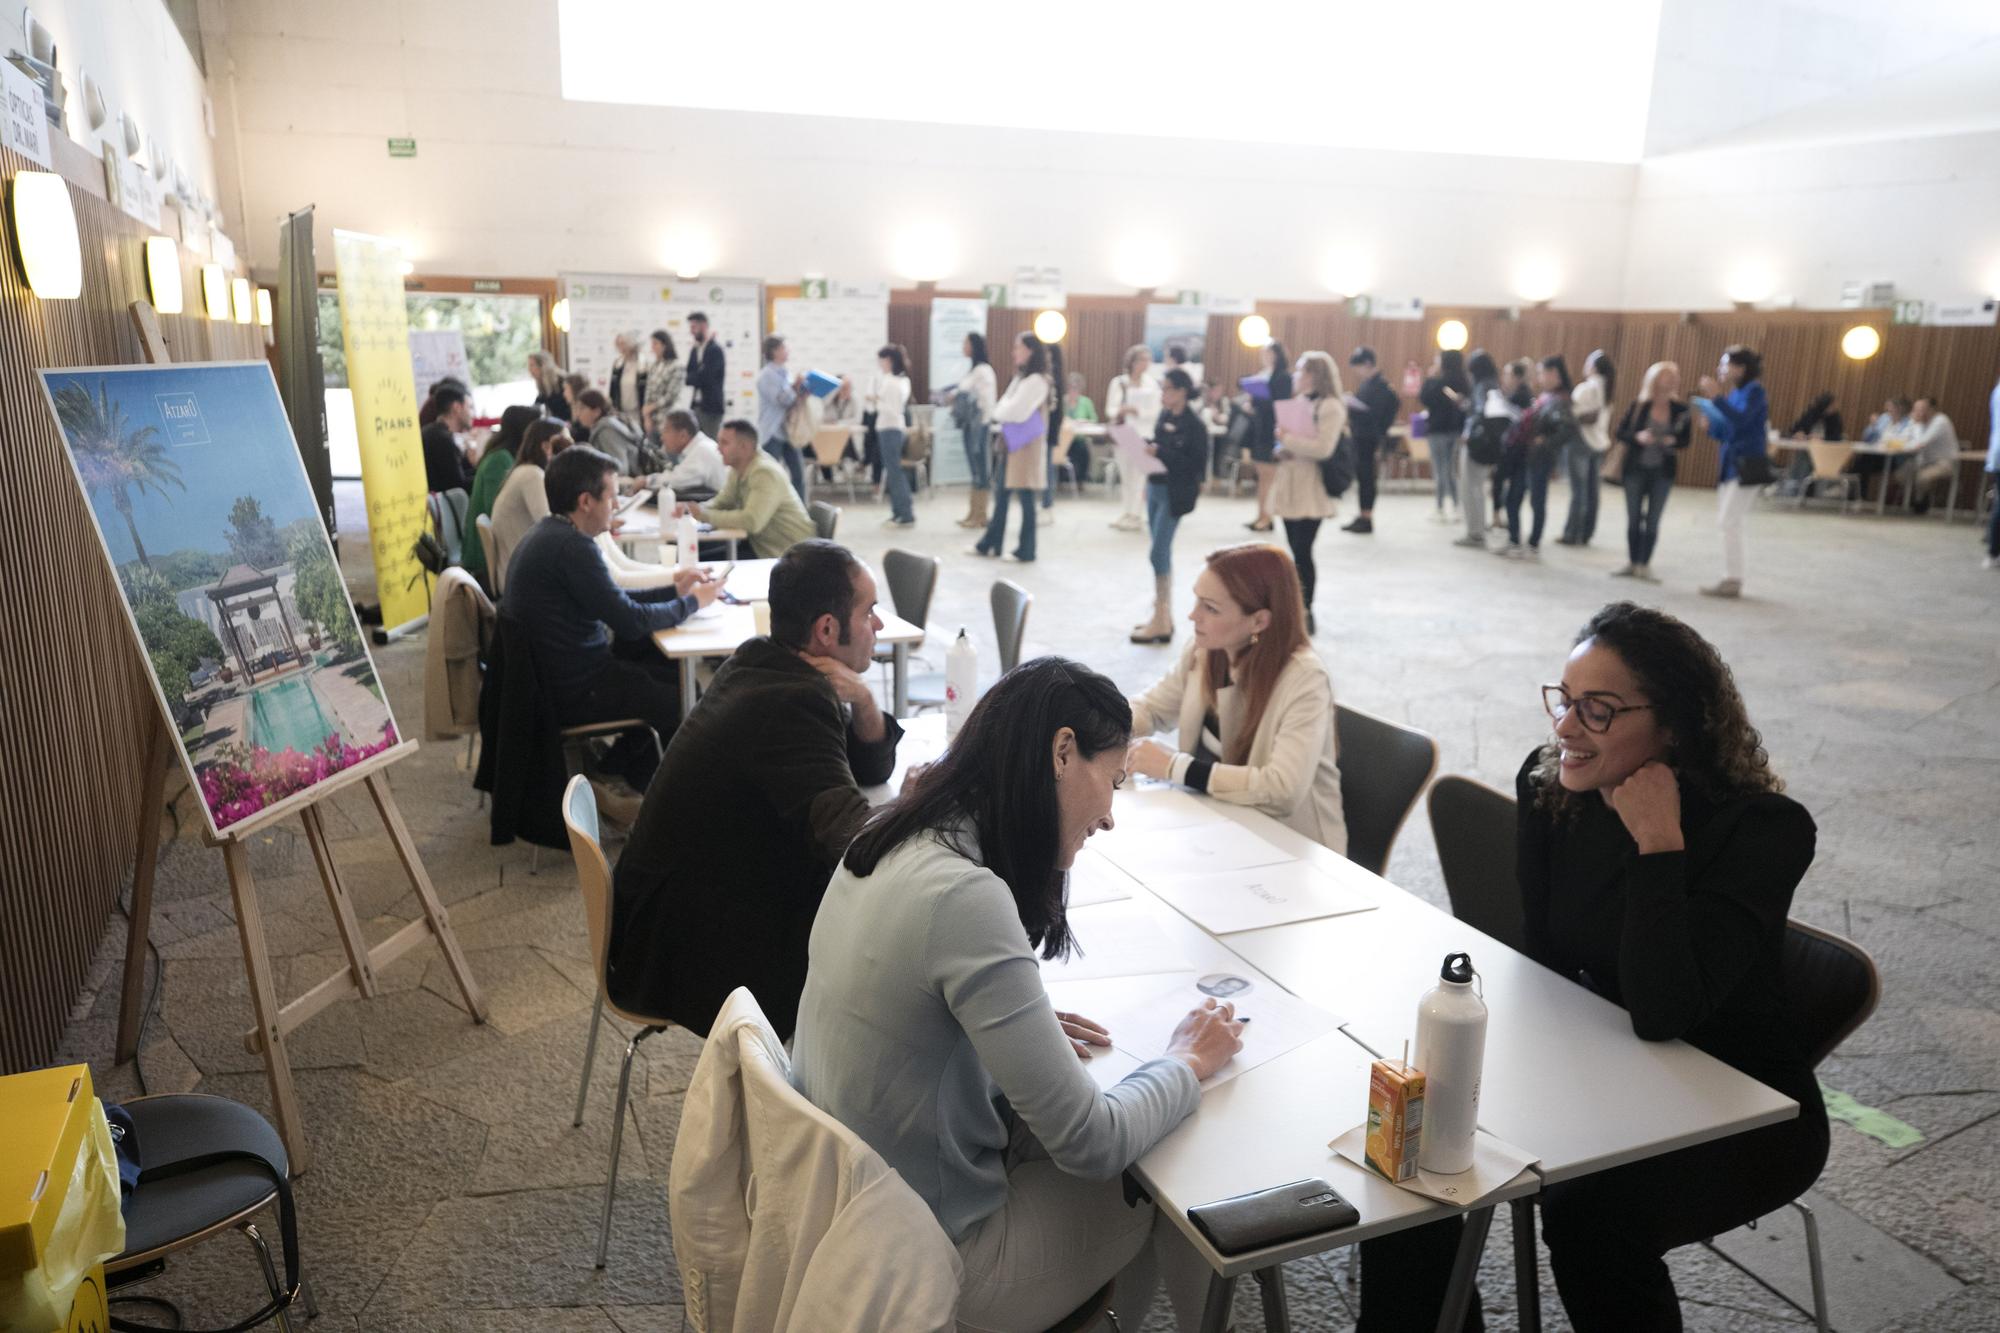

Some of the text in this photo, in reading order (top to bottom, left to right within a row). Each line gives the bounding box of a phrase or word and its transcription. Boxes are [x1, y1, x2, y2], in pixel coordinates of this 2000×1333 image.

[806, 279, 821, 298] 6
[986, 286, 1001, 305] 7
[1895, 302, 1922, 323] 10
